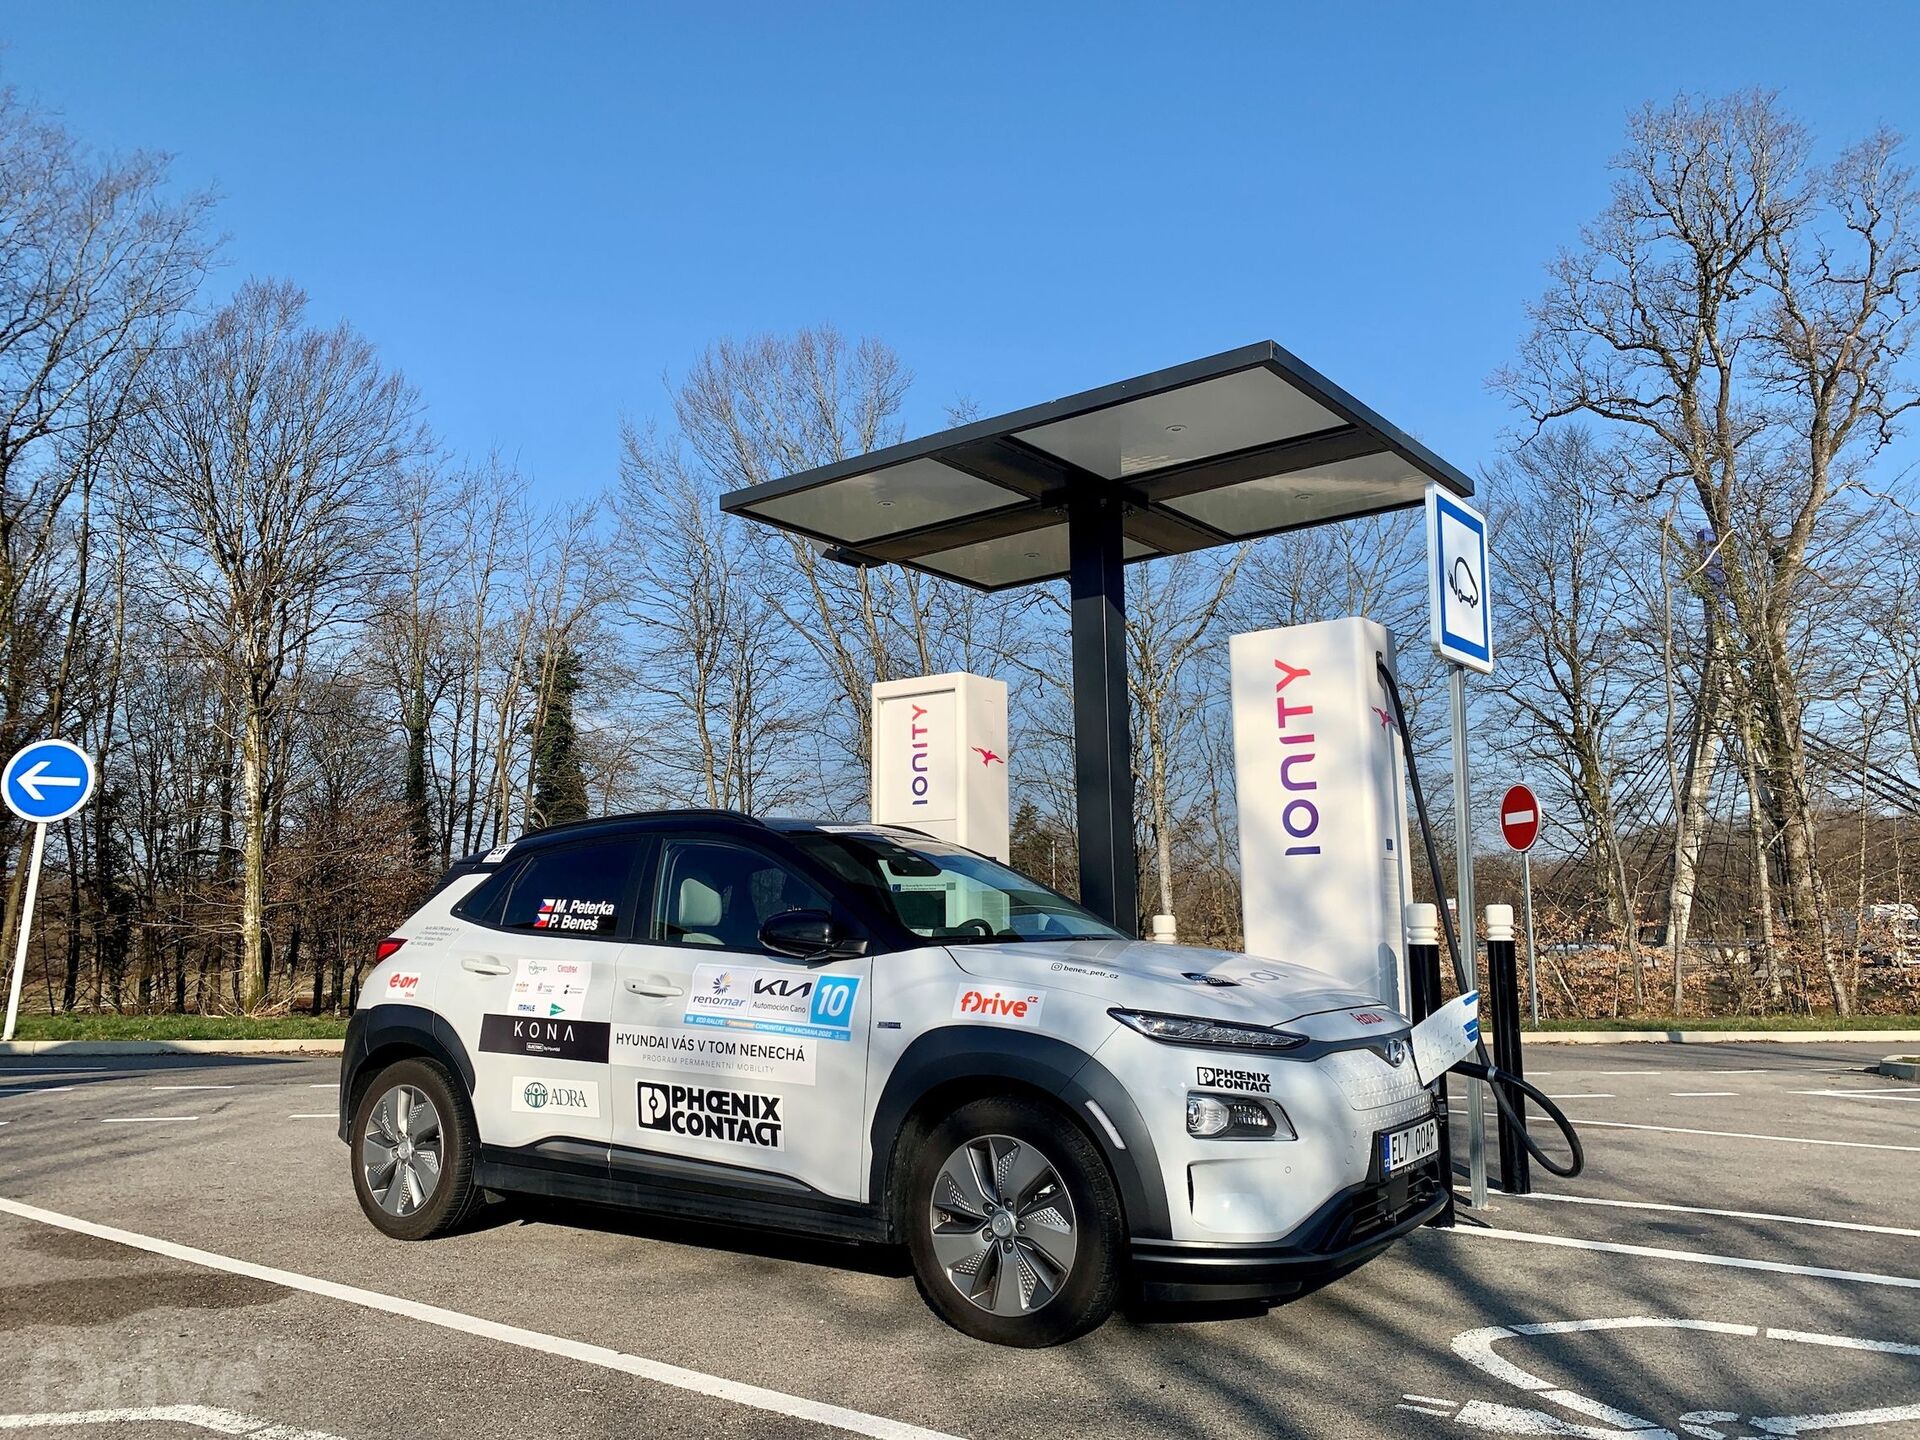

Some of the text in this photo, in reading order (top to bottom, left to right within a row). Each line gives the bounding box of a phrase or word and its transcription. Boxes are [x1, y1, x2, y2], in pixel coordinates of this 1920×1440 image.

[911, 704, 928, 805] IONITY
[1274, 658, 1321, 856] IONITY
[553, 899, 615, 915] M. Peterka
[548, 914, 600, 931] P. Beneš
[1063, 965, 1120, 980] benes_petr_cz
[753, 978, 813, 998] KIA
[693, 995, 746, 1008] renomar
[752, 1001, 807, 1014] Automoción Cano
[818, 984, 850, 1017] 10
[755, 1023, 784, 1033] COMUNITAT
[784, 1026, 819, 1037] VALENCIANA
[616, 1032, 806, 1062] HYUNDAI VÁS V TOM NENECHÁ
[642, 1054, 678, 1064] PROGRAM
[737, 1063, 775, 1074] MOBILITY
[1216, 1079, 1271, 1093] CONTACT
[549, 1088, 588, 1108] ADRA
[672, 1110, 782, 1148] CONTACT
[1391, 1132, 1410, 1165] EL7
